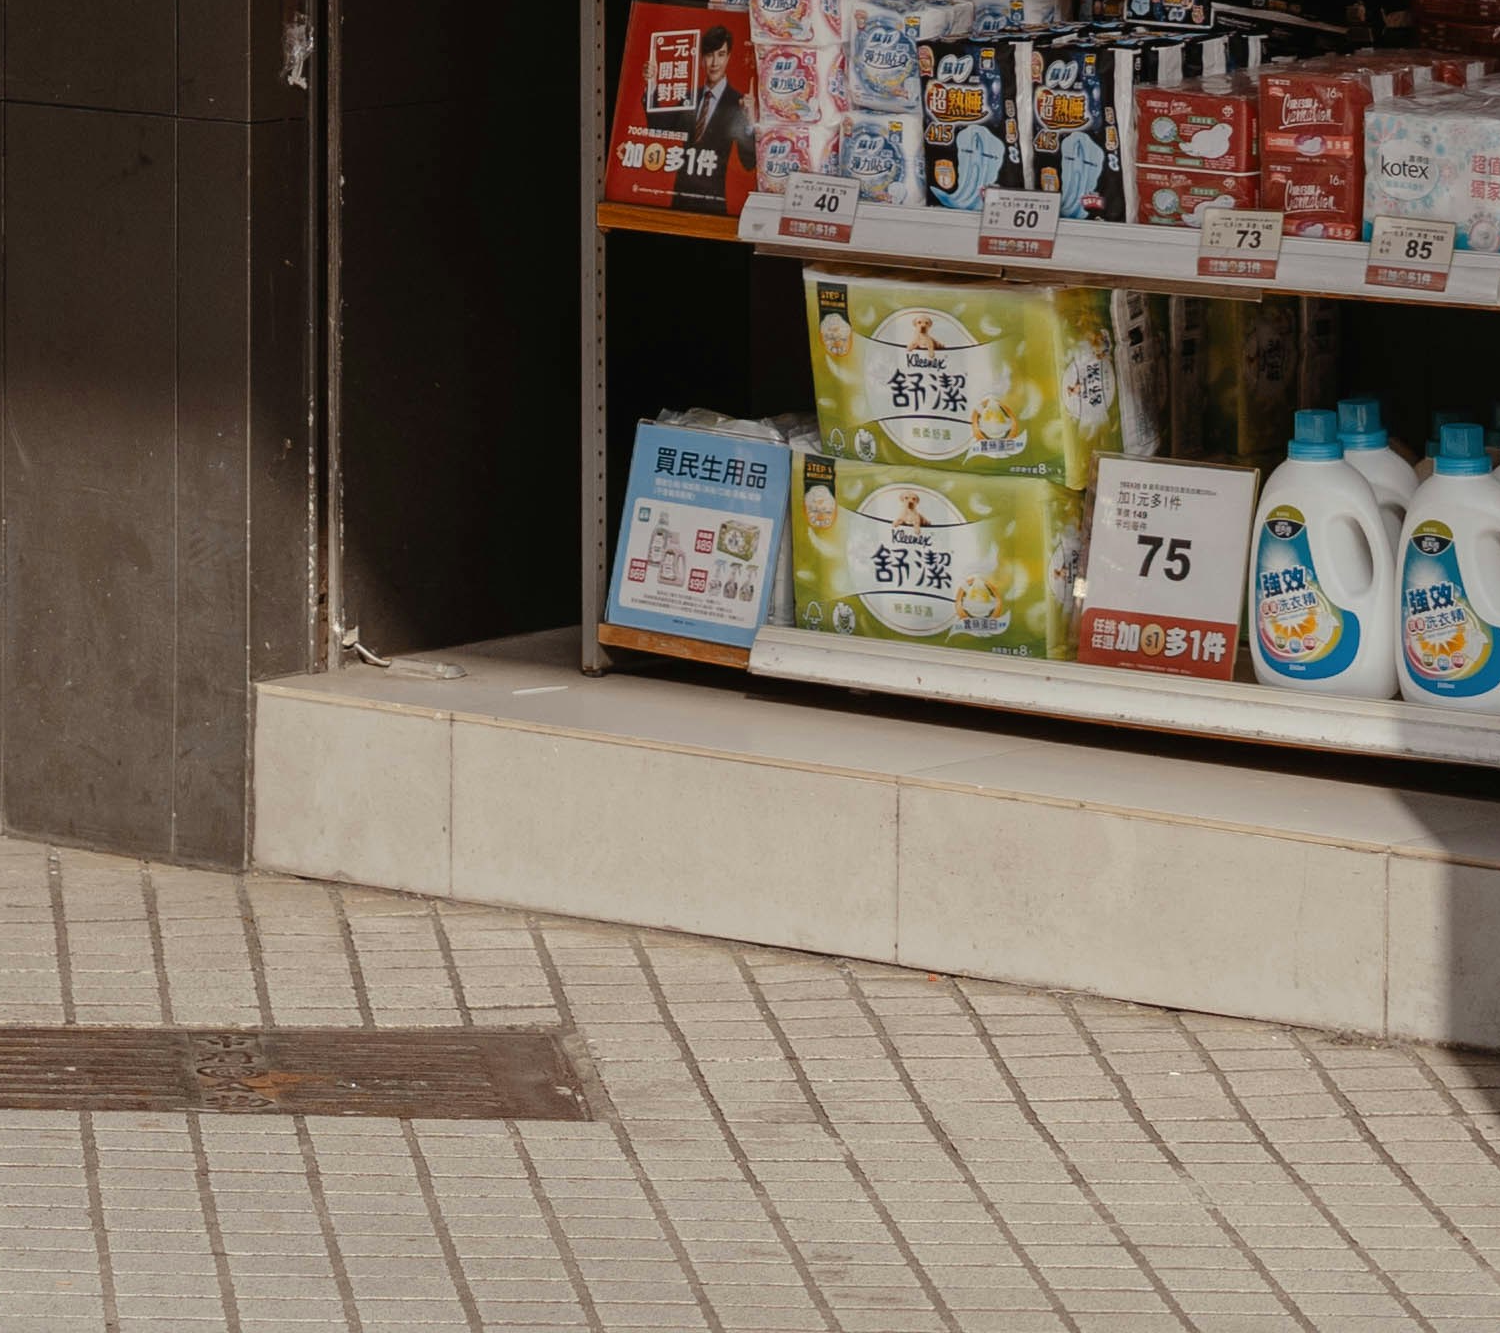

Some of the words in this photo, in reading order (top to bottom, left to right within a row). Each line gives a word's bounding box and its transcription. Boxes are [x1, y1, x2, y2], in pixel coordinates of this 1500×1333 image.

[660, 39, 691, 58] 一元
[927, 87, 986, 115] 超熟睡
[1039, 93, 1087, 121] 超熟睡
[925, 124, 953, 145] 415
[1380, 155, 1430, 181] kotex
[1470, 179, 1500, 202] 獨家
[814, 194, 839, 213] 40
[1013, 210, 1039, 228] 60
[1236, 231, 1262, 249] 73
[1404, 240, 1433, 260] 85
[905, 353, 949, 371] Kleenex
[887, 369, 968, 414] 舒潔
[654, 445, 768, 490] 買民生用品
[891, 528, 934, 548] Kleenex
[872, 545, 953, 590] 舒潔
[1136, 535, 1192, 582] 75
[1262, 565, 1306, 599] 強效
[1408, 582, 1455, 616] 強效
